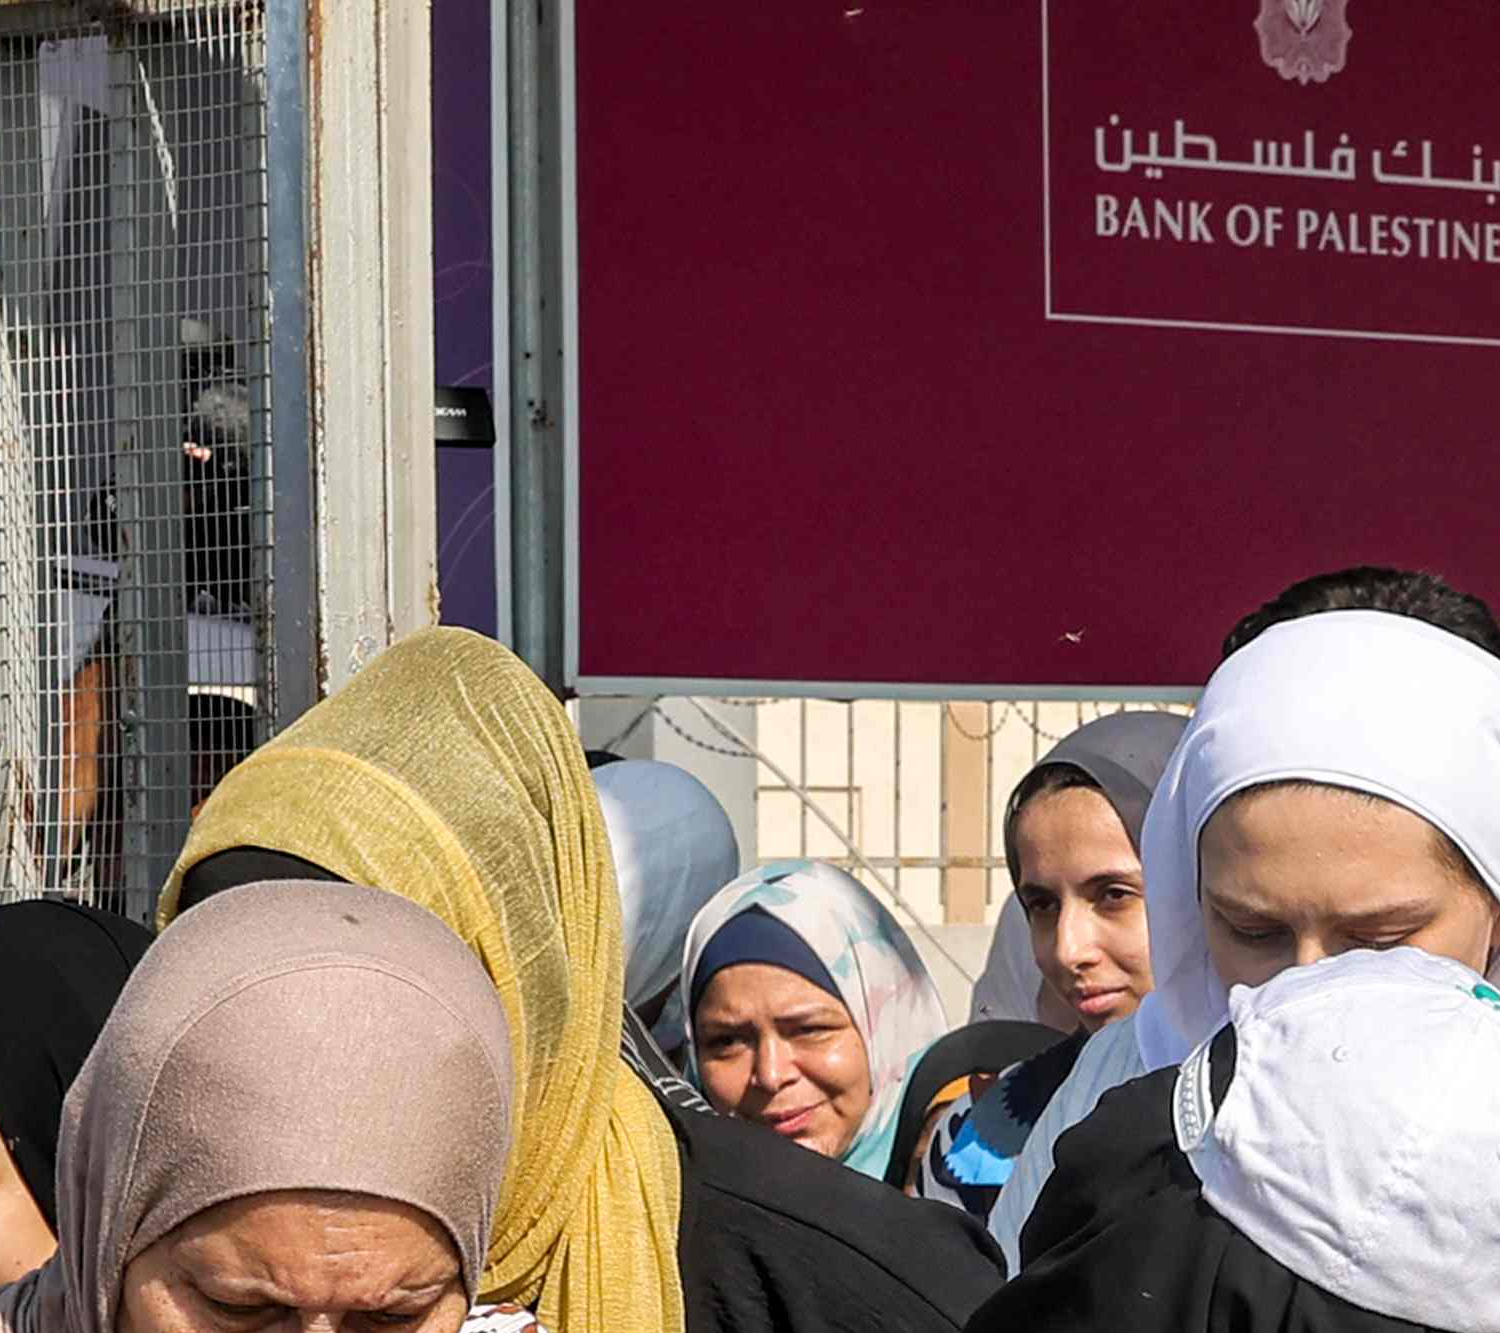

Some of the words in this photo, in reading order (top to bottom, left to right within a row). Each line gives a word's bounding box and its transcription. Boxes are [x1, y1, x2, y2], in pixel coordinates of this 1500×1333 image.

[1095, 113, 1357, 180] فلسطين
[1095, 194, 1215, 243] BANK
[1225, 203, 1284, 248] OF
